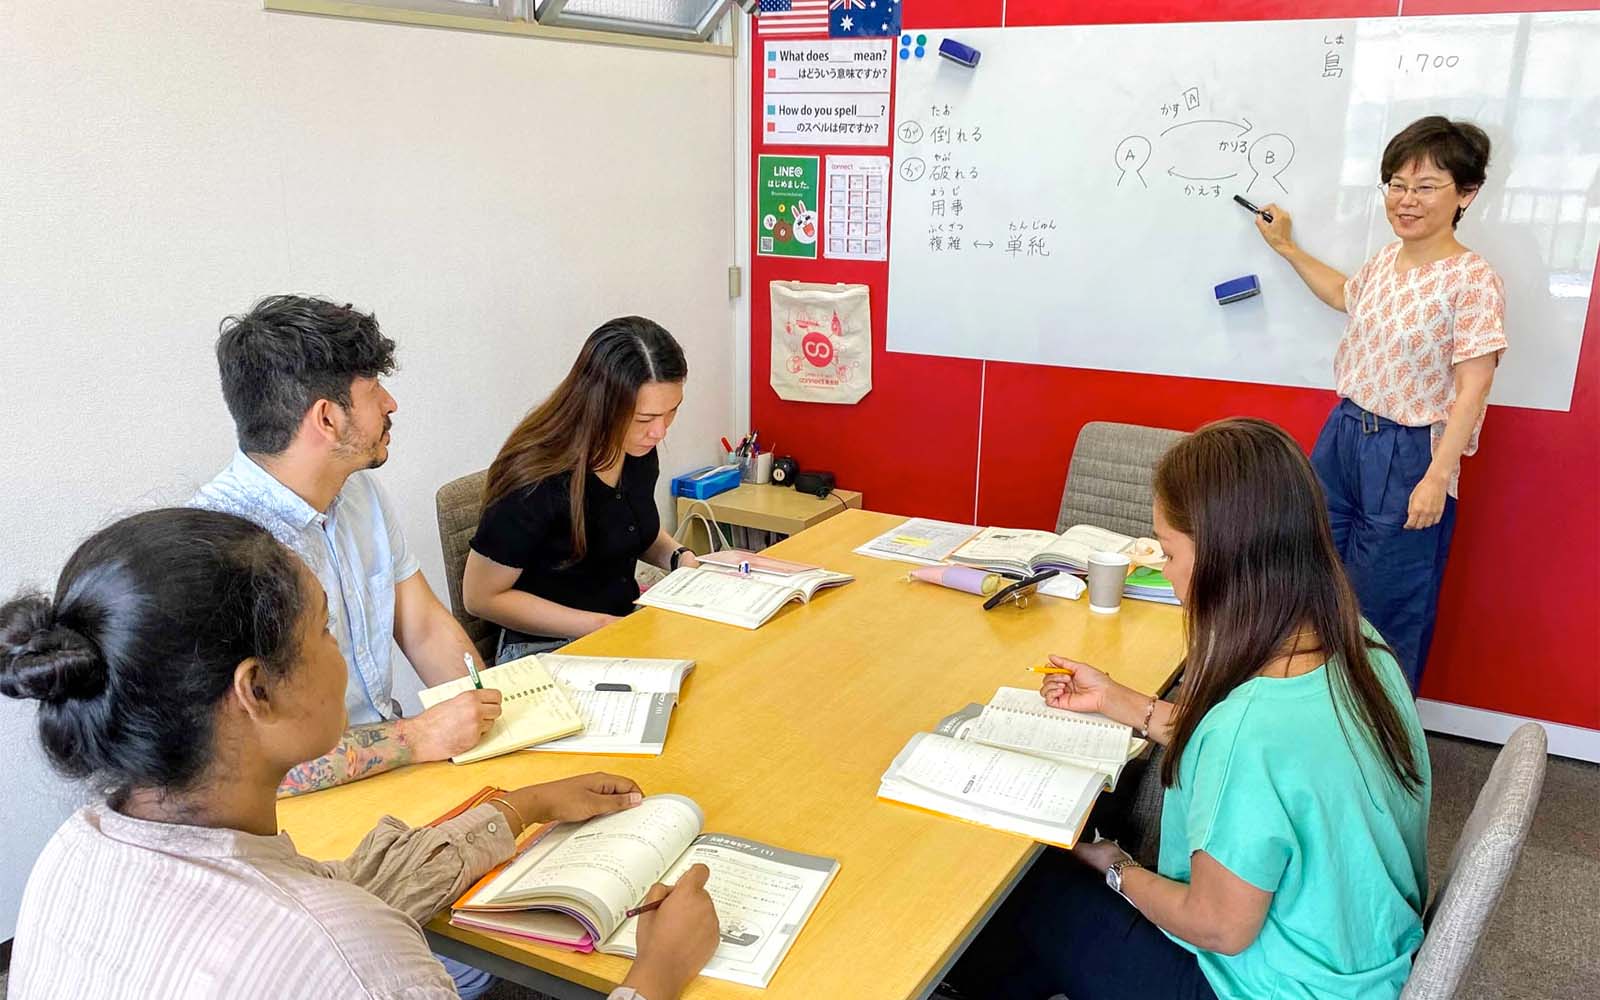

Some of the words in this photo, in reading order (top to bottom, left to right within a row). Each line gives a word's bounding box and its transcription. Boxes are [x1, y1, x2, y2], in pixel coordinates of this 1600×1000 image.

[1323, 35, 1345, 45] しま
[779, 49, 804, 61] What
[806, 49, 829, 61] does
[853, 49, 887, 61] mean?
[1321, 50, 1343, 79] 島
[778, 104, 799, 116] How
[800, 104, 813, 116] do
[814, 107, 833, 119] you
[834, 104, 857, 119] spell
[931, 103, 953, 117] たお
[1160, 103, 1181, 119] かす
[930, 125, 983, 145] 倒れる
[1218, 140, 1248, 153] かりる
[934, 152, 952, 162] やぶ
[1124, 149, 1136, 161] A
[1264, 150, 1276, 165] B
[773, 166, 803, 178] LINE@
[929, 165, 979, 181] 破れる
[1184, 184, 1222, 198] かえす
[931, 199, 964, 217] 用事
[929, 235, 961, 252] 複雑
[1005, 233, 1050, 258] 単純
